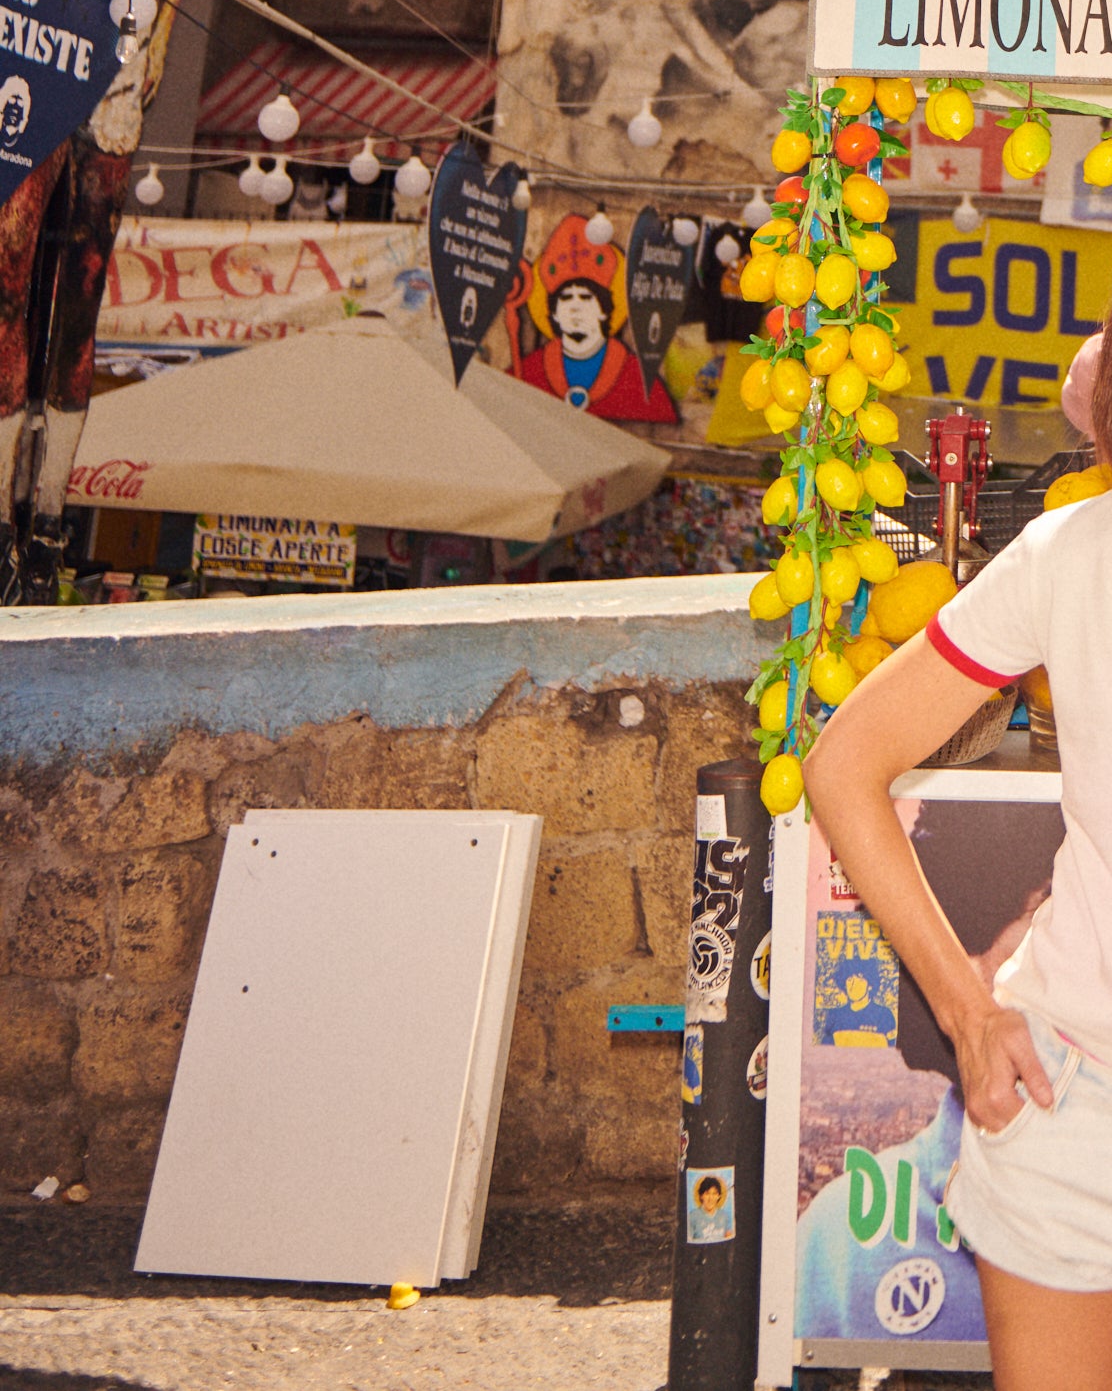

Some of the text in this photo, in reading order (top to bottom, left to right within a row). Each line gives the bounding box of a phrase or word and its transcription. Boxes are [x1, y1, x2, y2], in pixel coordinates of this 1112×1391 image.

[816, 916, 888, 939] DIEG
[826, 938, 894, 961] VIVE
[845, 1147, 921, 1244] DI
